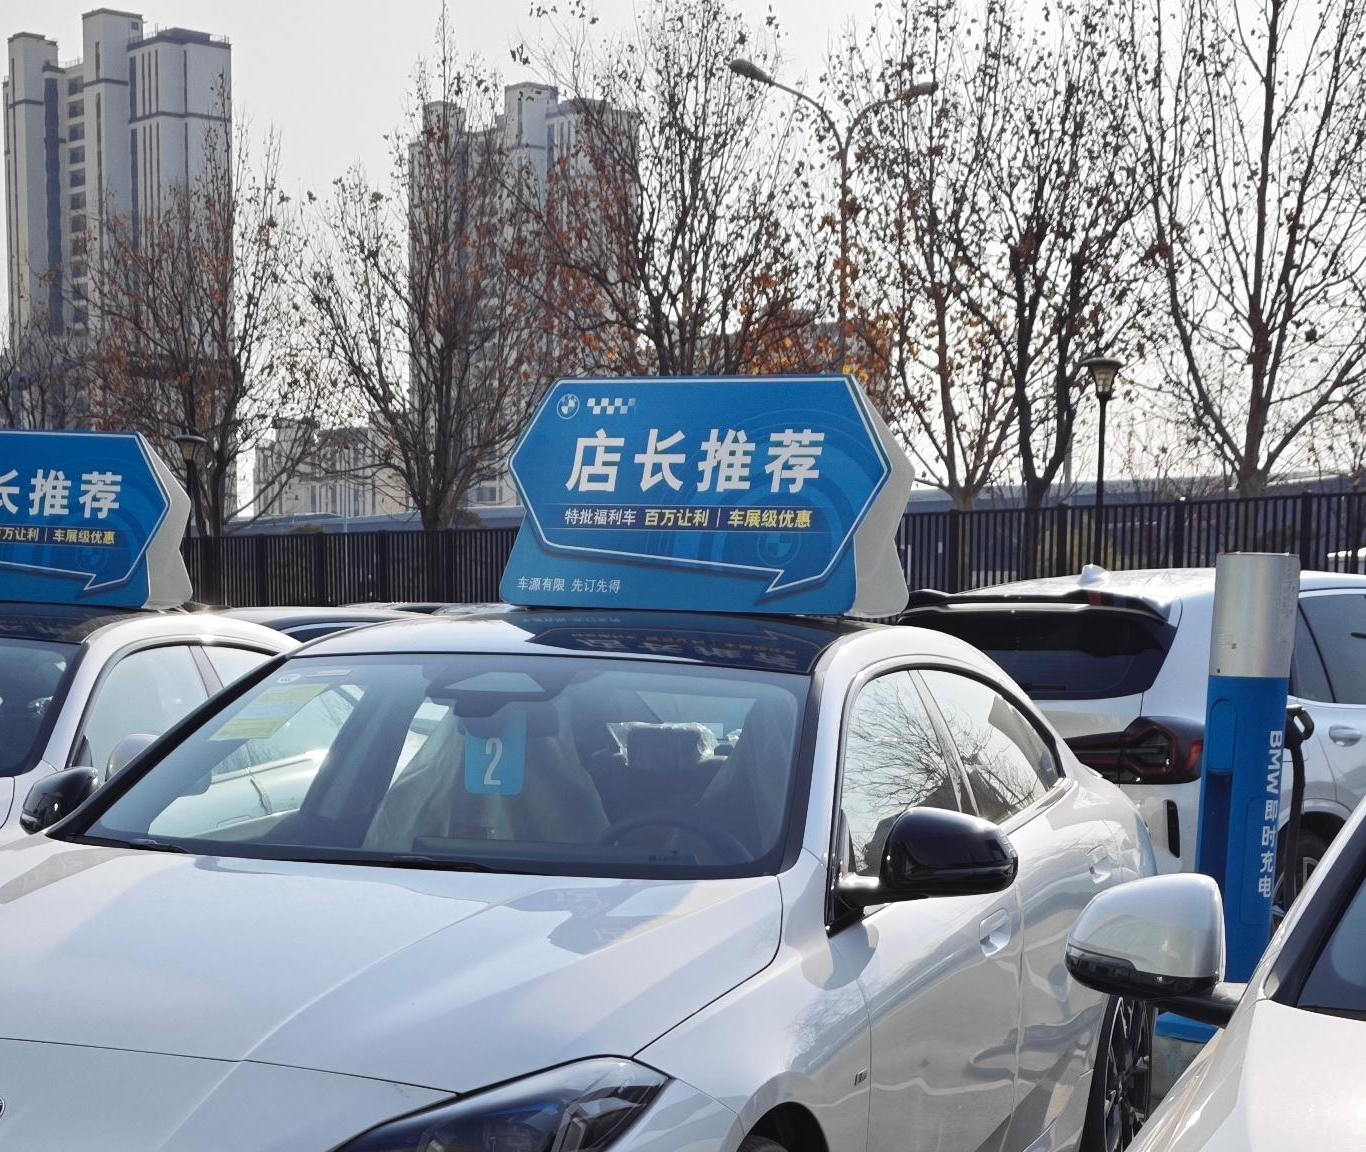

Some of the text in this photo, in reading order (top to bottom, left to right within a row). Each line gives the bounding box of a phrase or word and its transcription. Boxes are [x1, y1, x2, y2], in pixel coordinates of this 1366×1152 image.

[564, 428, 825, 493] 店长推荐
[53, 528, 115, 545] 车展级优惠
[564, 508, 812, 529] 特批福利车 百万让利 车展级优惠
[517, 575, 621, 594] 车源有限 先订先得
[483, 737, 503, 786] 2
[1266, 730, 1284, 795] BMW
[1258, 799, 1280, 898] 即时充电
